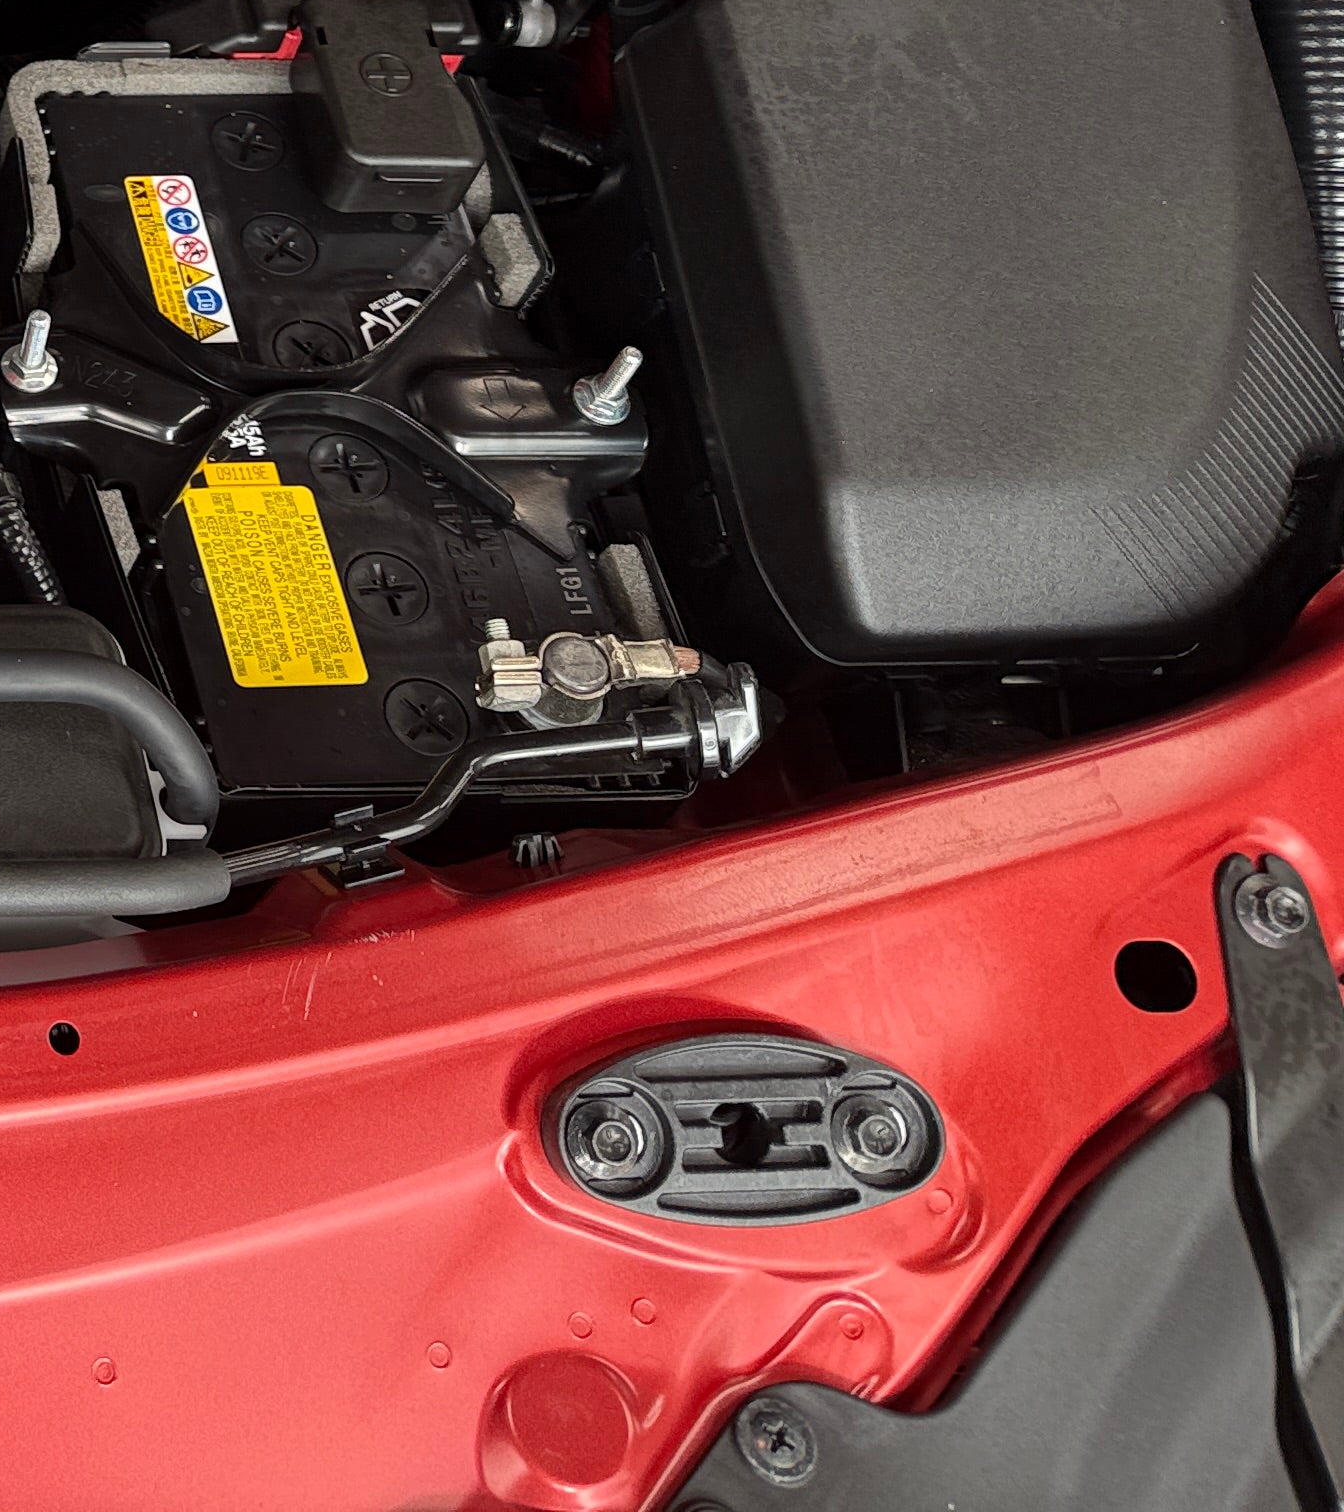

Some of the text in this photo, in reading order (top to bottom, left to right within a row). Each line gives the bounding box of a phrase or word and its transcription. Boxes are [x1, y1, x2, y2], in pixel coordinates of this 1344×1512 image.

[368, 290, 404, 312] RETURN
[236, 509, 266, 557] POISON
[299, 514, 333, 571] DANGER
[331, 622, 354, 653] GASES
[555, 567, 594, 616] LFG1
